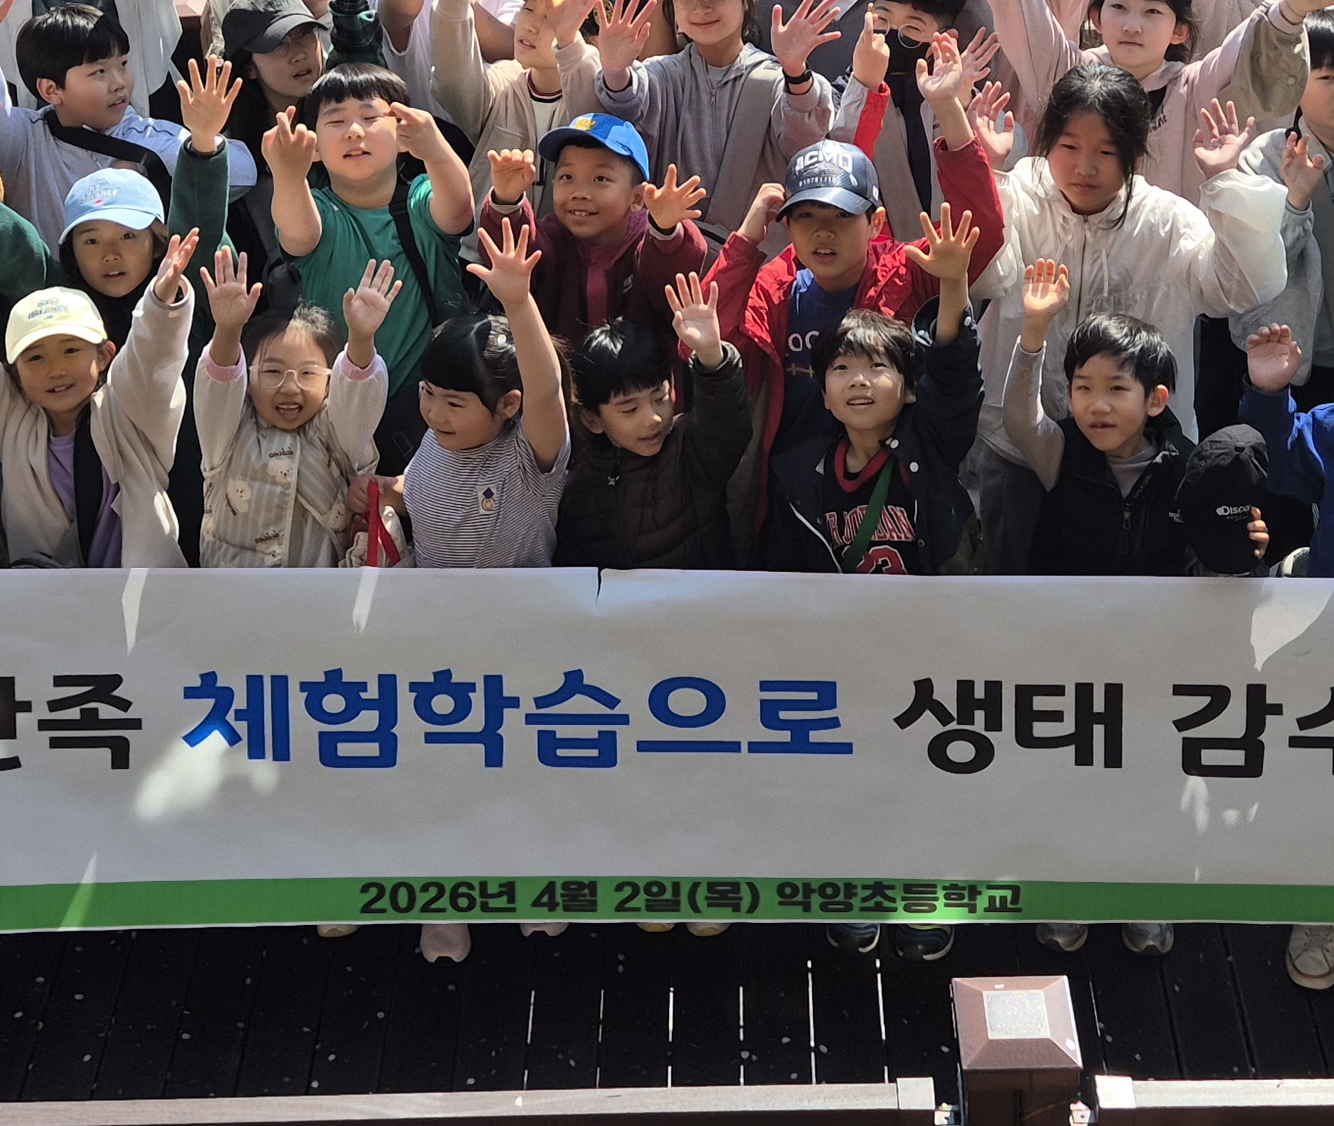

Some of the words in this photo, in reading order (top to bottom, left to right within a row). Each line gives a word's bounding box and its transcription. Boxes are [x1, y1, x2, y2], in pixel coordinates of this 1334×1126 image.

[182, 668, 854, 769] 체험학습으로
[894, 677, 1124, 775] 생태
[359, 880, 517, 914] 2026년
[530, 880, 598, 913] 4월
[613, 881, 761, 914] 2일(목)
[776, 881, 1023, 914] 악양초등학교
